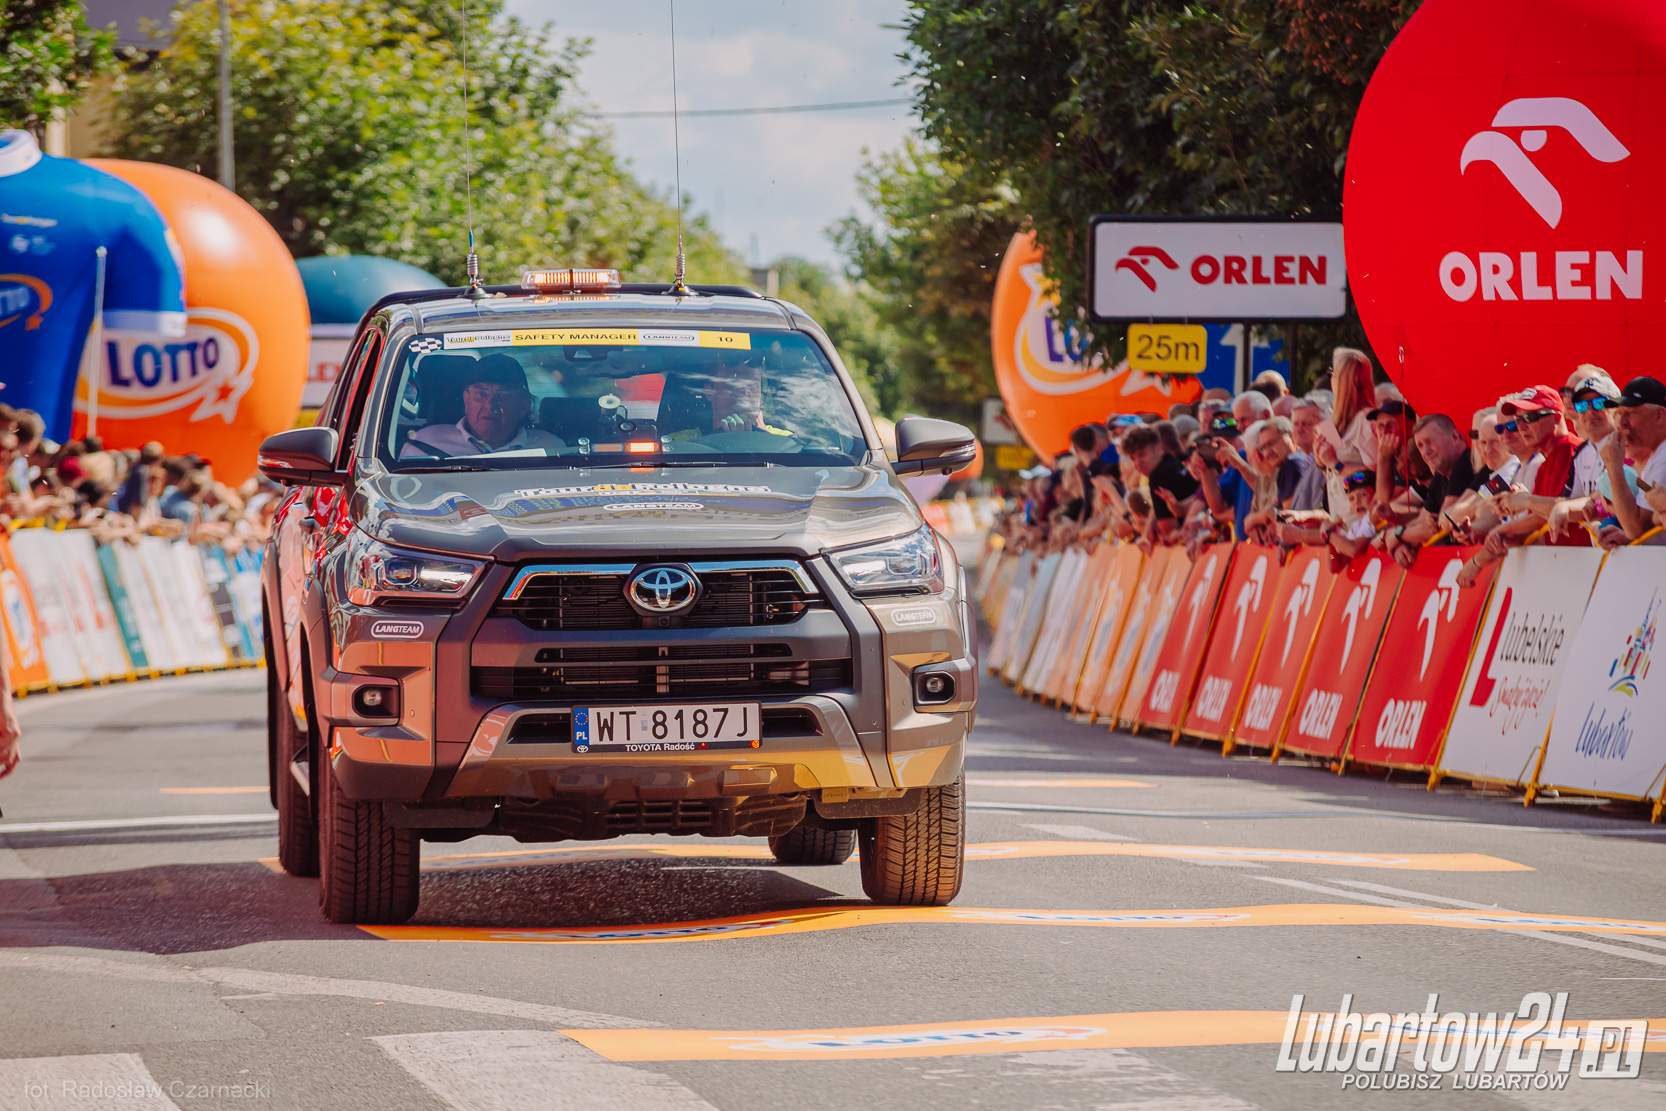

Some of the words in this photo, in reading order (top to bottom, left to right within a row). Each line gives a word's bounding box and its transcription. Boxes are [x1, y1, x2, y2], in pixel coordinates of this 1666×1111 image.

[1190, 255, 1327, 285] ORLEN
[1439, 250, 1644, 302] ORLEN
[515, 333, 565, 341] SAFETY
[1137, 334, 1200, 362] 25m
[107, 337, 219, 388] LOTTO
[375, 624, 420, 634] LANGTEAM
[597, 710, 637, 742] WT
[652, 707, 748, 740] 8187J
[1299, 688, 1344, 740] ORLEN
[1375, 698, 1428, 750] ORLEN
[576, 732, 588, 740] PL
[625, 744, 662, 752] TOYOTA
[664, 742, 696, 752] Radość
